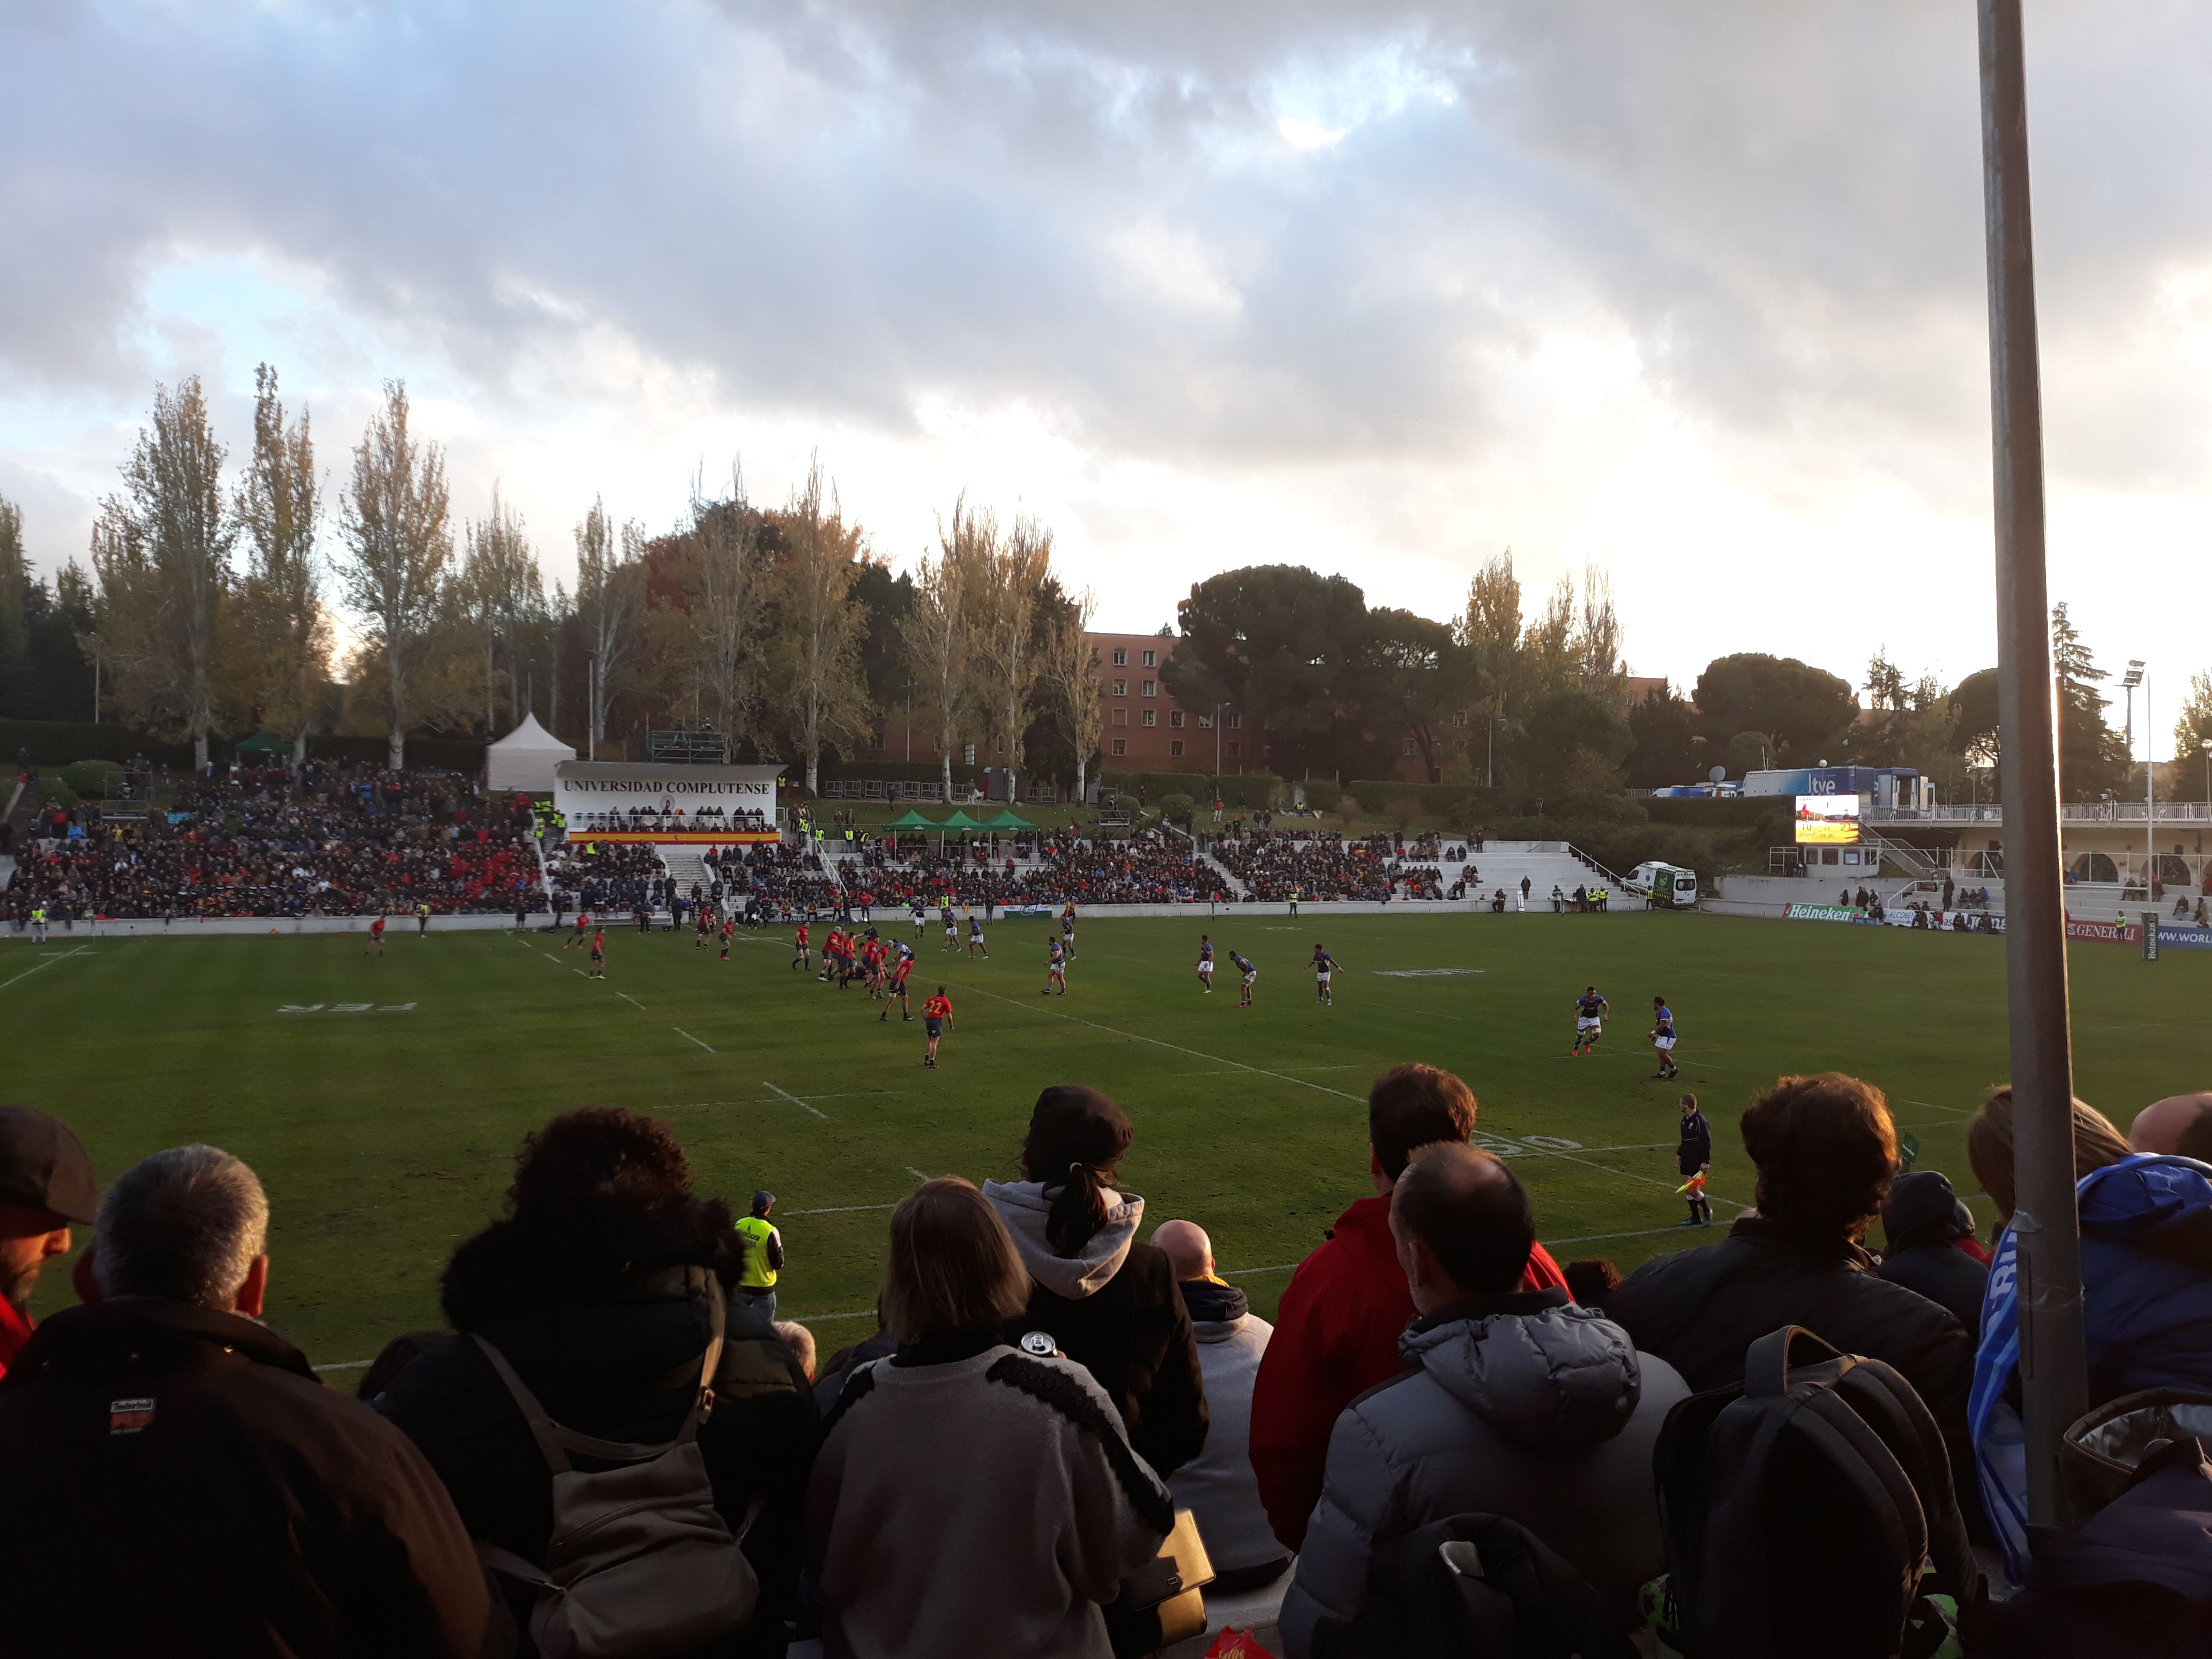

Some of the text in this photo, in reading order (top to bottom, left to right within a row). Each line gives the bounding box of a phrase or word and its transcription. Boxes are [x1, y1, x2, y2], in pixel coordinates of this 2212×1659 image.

[564, 780, 770, 794] UNIVERSIDAD COMPLUTENSE
[1840, 823, 1851, 832] 21
[1790, 905, 1850, 921] Heineken
[2148, 922, 2156, 959] Heineken
[2158, 932, 2212, 943] WW.WORL
[929, 1000, 941, 1014] 22
